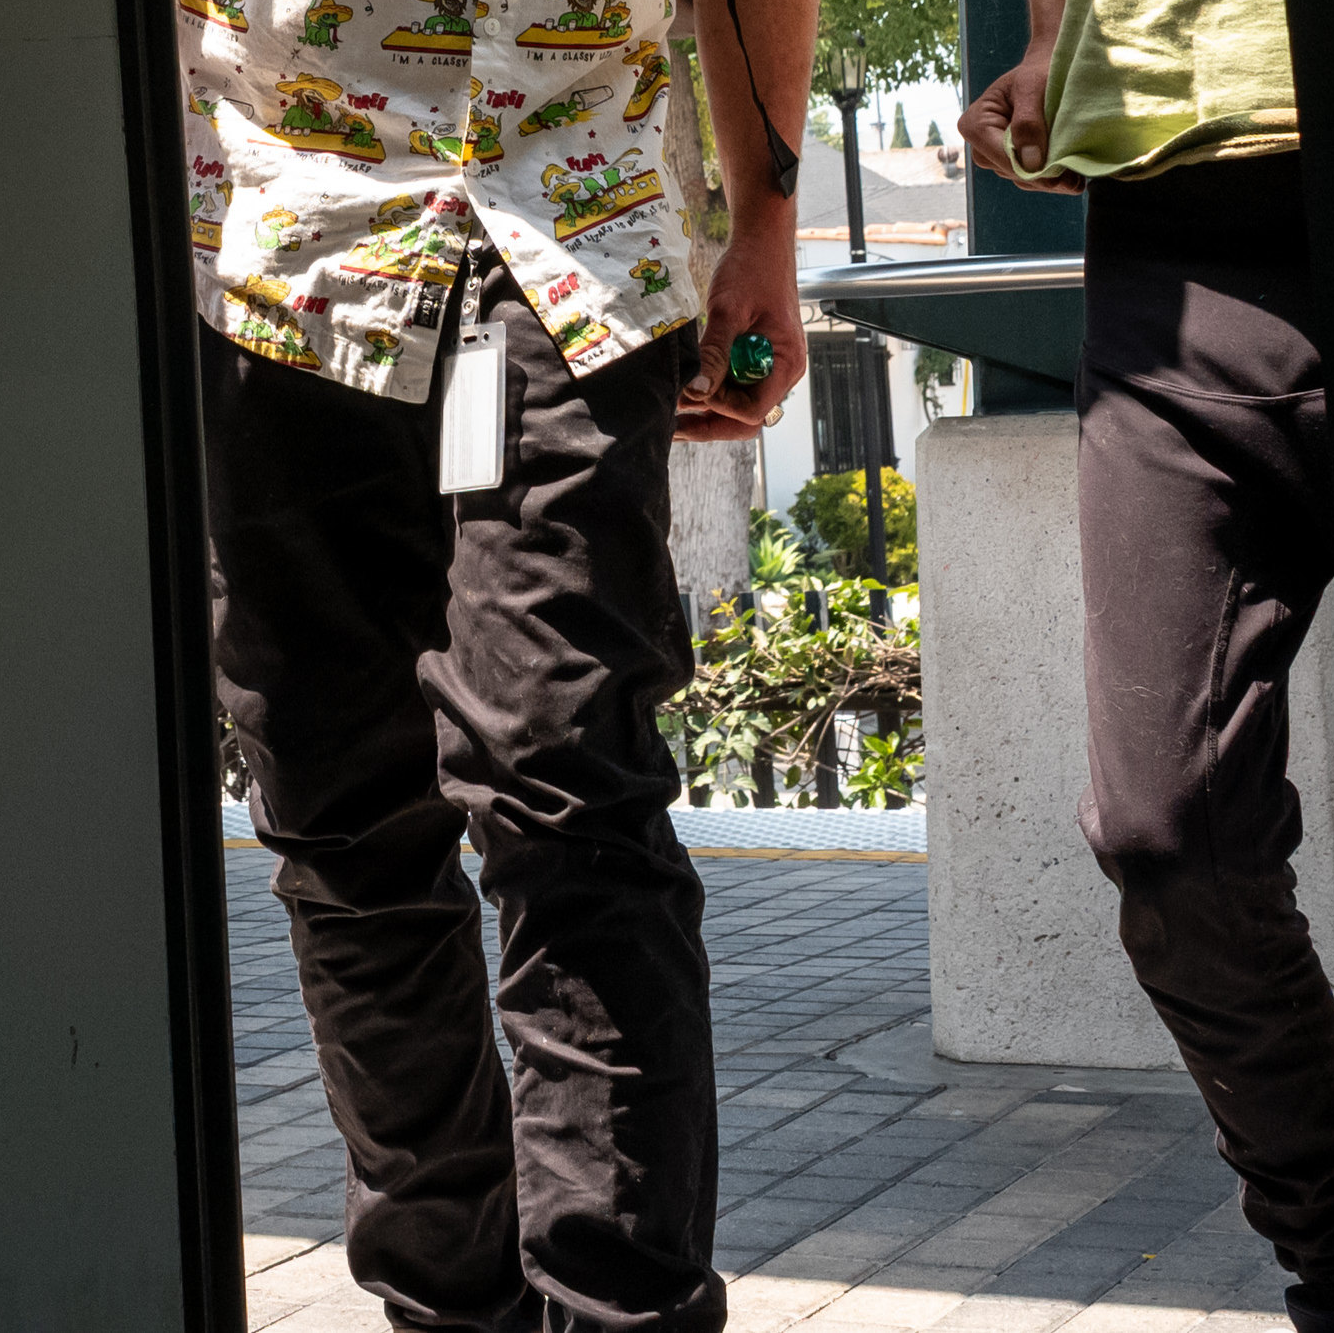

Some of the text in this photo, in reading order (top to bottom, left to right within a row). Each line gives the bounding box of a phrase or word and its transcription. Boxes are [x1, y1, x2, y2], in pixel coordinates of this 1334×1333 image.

[393, 55, 468, 68] I'M A CLASSY
[527, 50, 595, 63] I'M A CLASSY
[346, 92, 389, 112] THREE
[486, 89, 526, 109] THREE
[339, 158, 372, 173] LIZARD
[566, 209, 647, 253] THIS LIZARD BUCK
[548, 272, 580, 306] ONE
[292, 292, 328, 316] ONE
